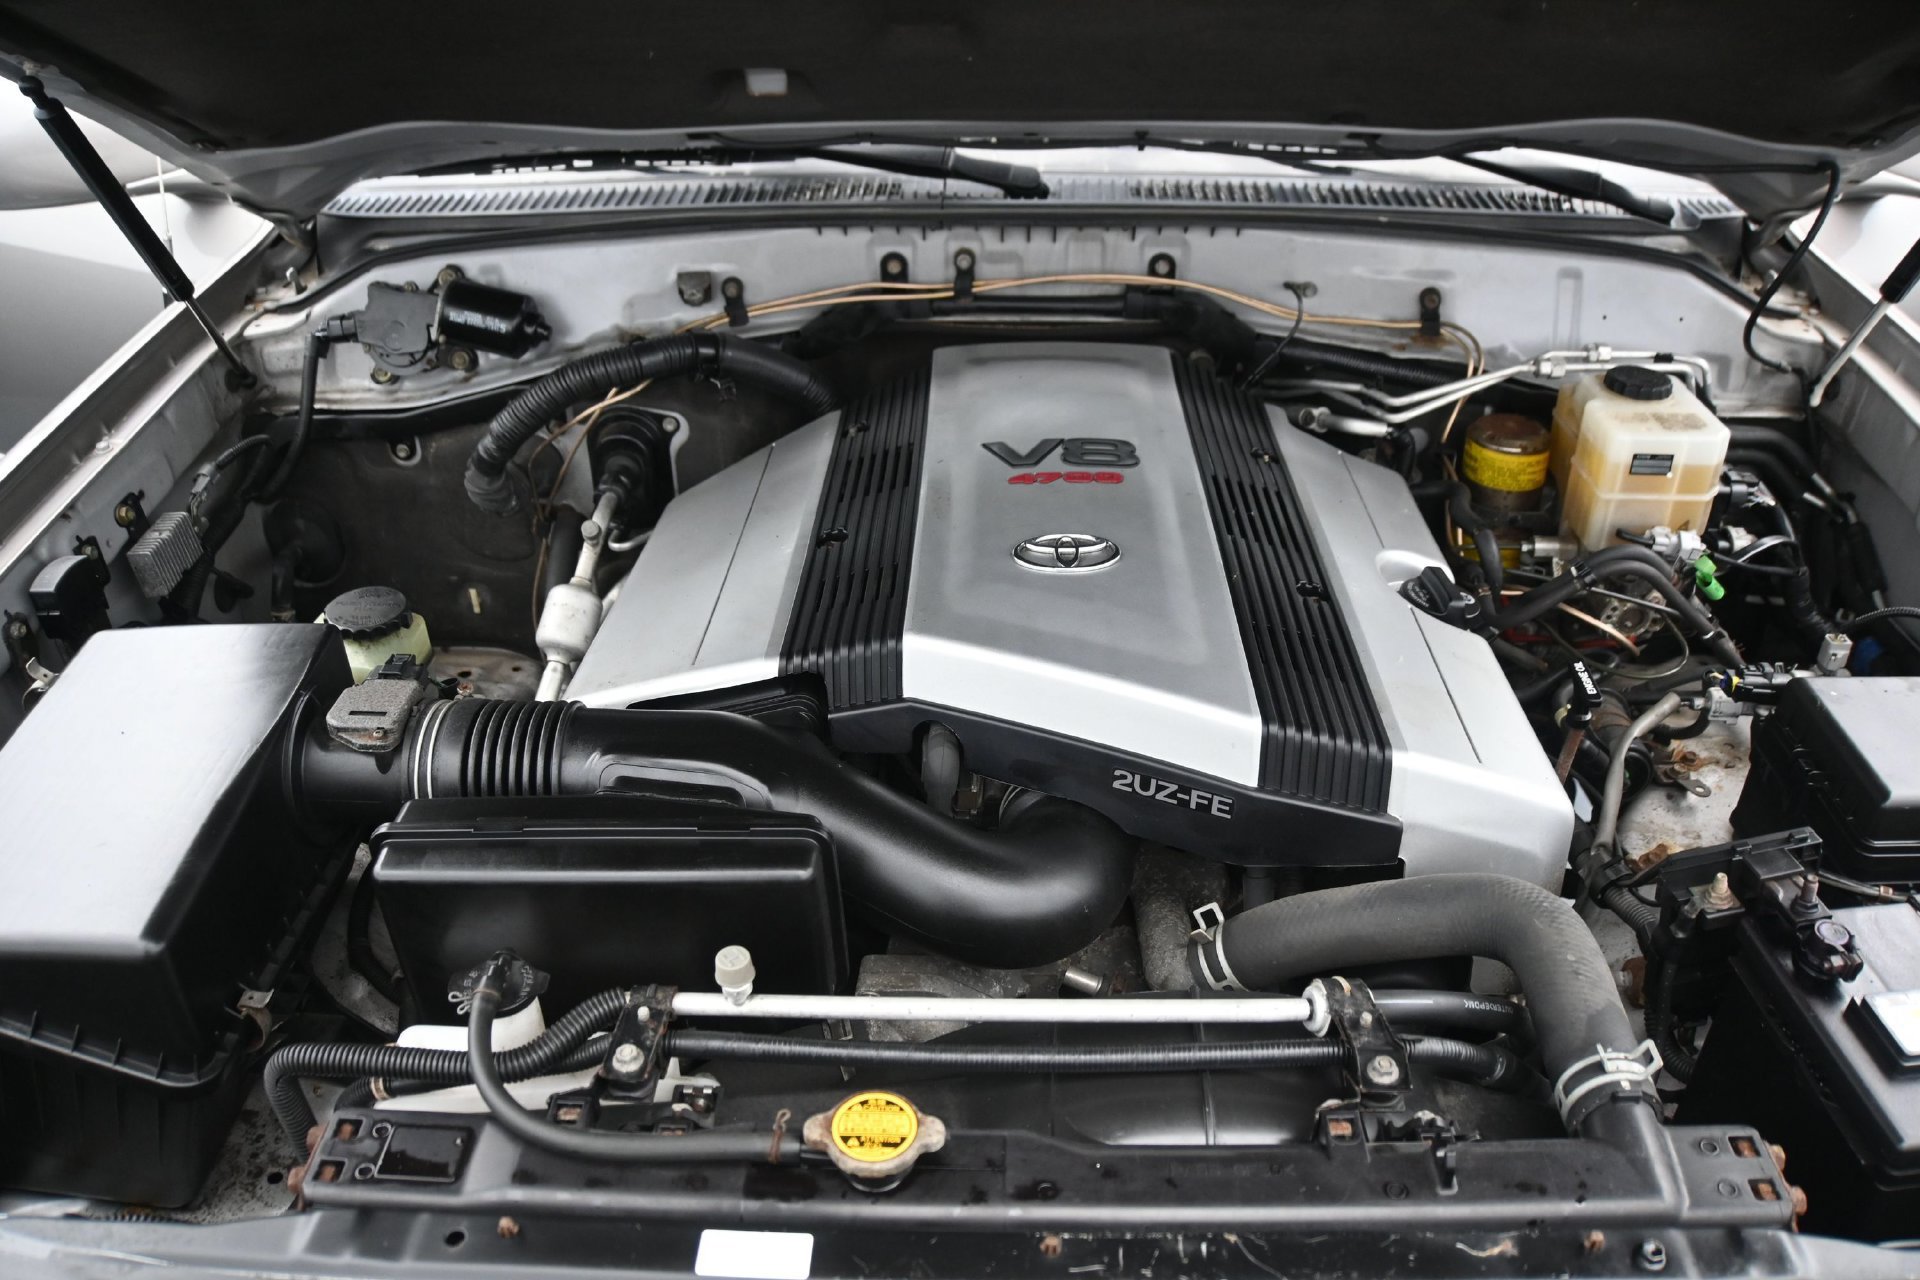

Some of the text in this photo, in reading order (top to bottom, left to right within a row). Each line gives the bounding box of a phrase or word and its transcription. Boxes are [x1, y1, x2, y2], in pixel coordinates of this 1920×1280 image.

[982, 438, 1140, 468] V8
[1007, 471, 1124, 484] 4700
[1574, 660, 1597, 694] ENGINE OIL
[1112, 769, 1233, 819] 2UZ-FE
